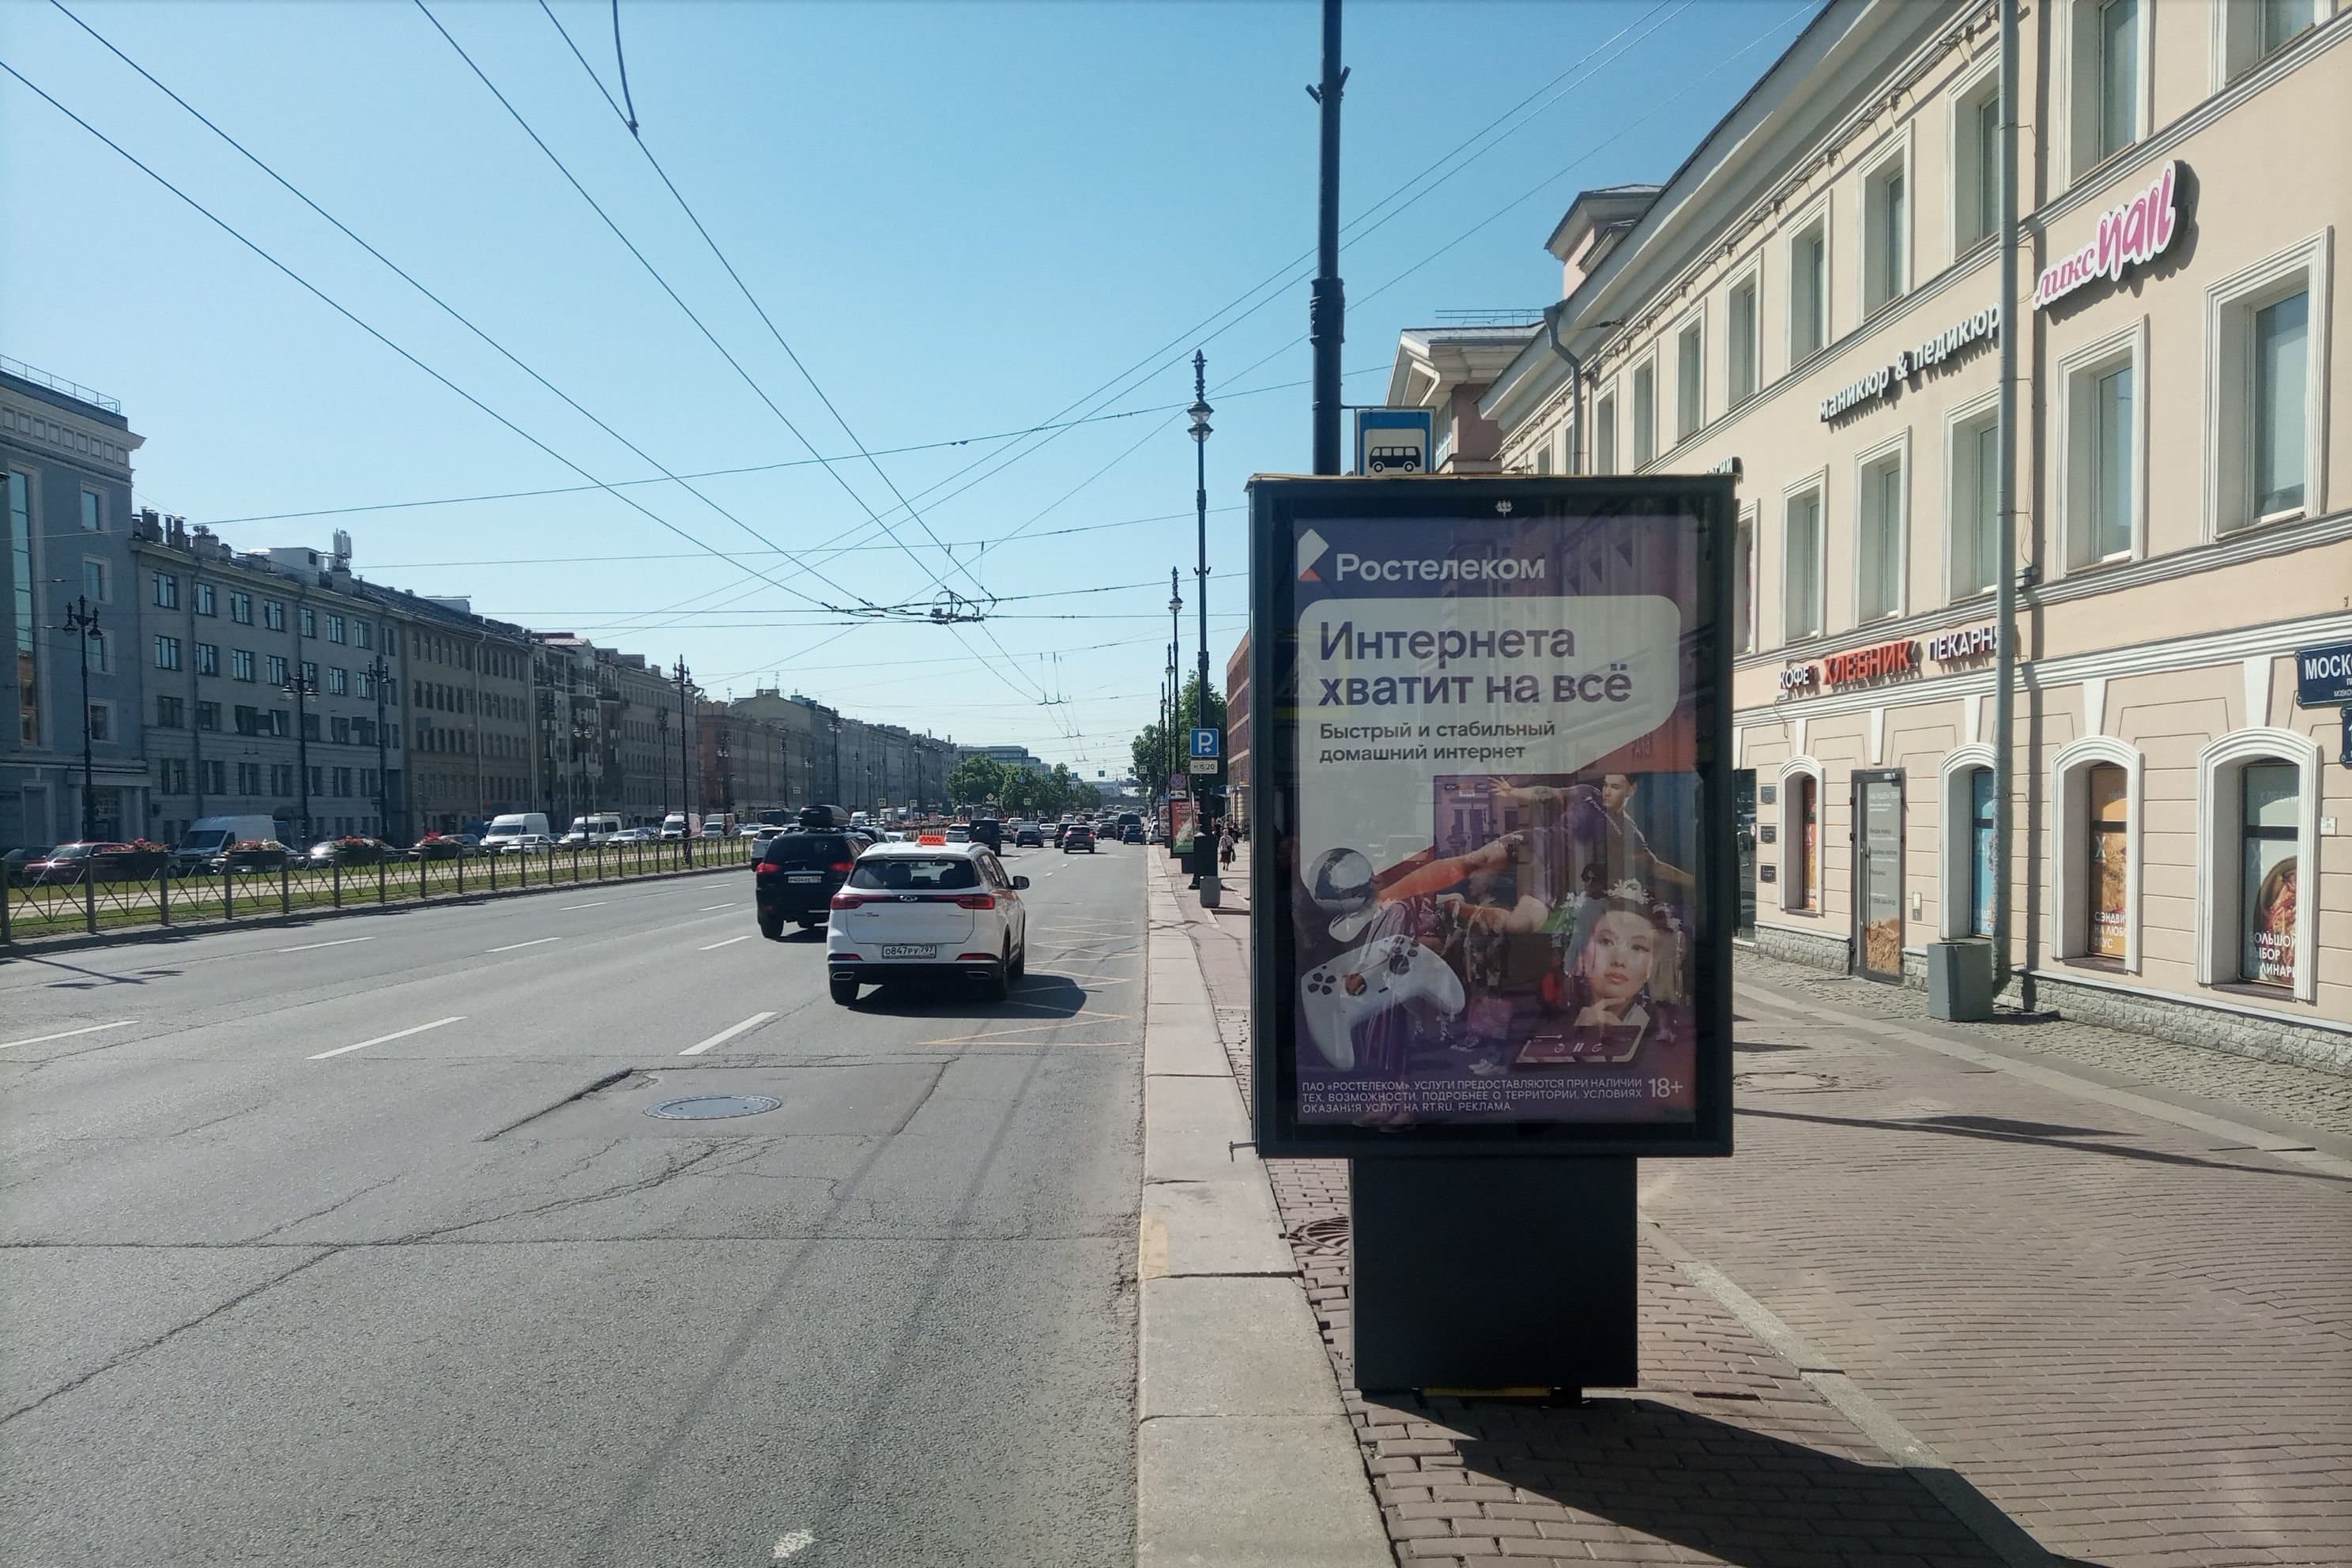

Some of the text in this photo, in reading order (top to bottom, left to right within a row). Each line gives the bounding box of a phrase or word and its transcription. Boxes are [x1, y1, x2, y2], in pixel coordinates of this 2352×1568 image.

[1820, 303, 2000, 420] маникюр & педикюр
[1336, 553, 1545, 582] Ростелеком
[1320, 621, 1575, 669] Интернета
[1780, 668, 1809, 689] КОФЕ
[1823, 641, 1911, 685] ХЛЕБНИК
[2305, 653, 2352, 681] МОСК
[1318, 664, 1632, 707] хватит на всё
[1321, 721, 1555, 741] Быстрый и стабильный
[1320, 744, 1525, 763] домашний интернет
[1302, 1082, 1325, 1091] ПАО
[1414, 1080, 1455, 1090] УСЛУГИ
[1457, 1080, 1564, 1090] ПРЕДОСТАВЛЯЮТСЯ
[1566, 1080, 1589, 1088] ПРИ
[1591, 1079, 1642, 1088] НАЛИЧИИ
[1302, 1093, 1325, 1102] ТЕХ.
[1422, 1091, 1488, 1102] ПОДРОБНЕЕ
[1492, 1091, 1501, 1100] О
[1582, 1089, 1642, 1099] УСЛОВИЯХ
[1648, 1078, 1683, 1098] 18+
[1302, 1104, 1362, 1113] ОКАЗАНИЯ
[1366, 1103, 1400, 1113] УСЛУГ
[1404, 1103, 1419, 1112] НА
